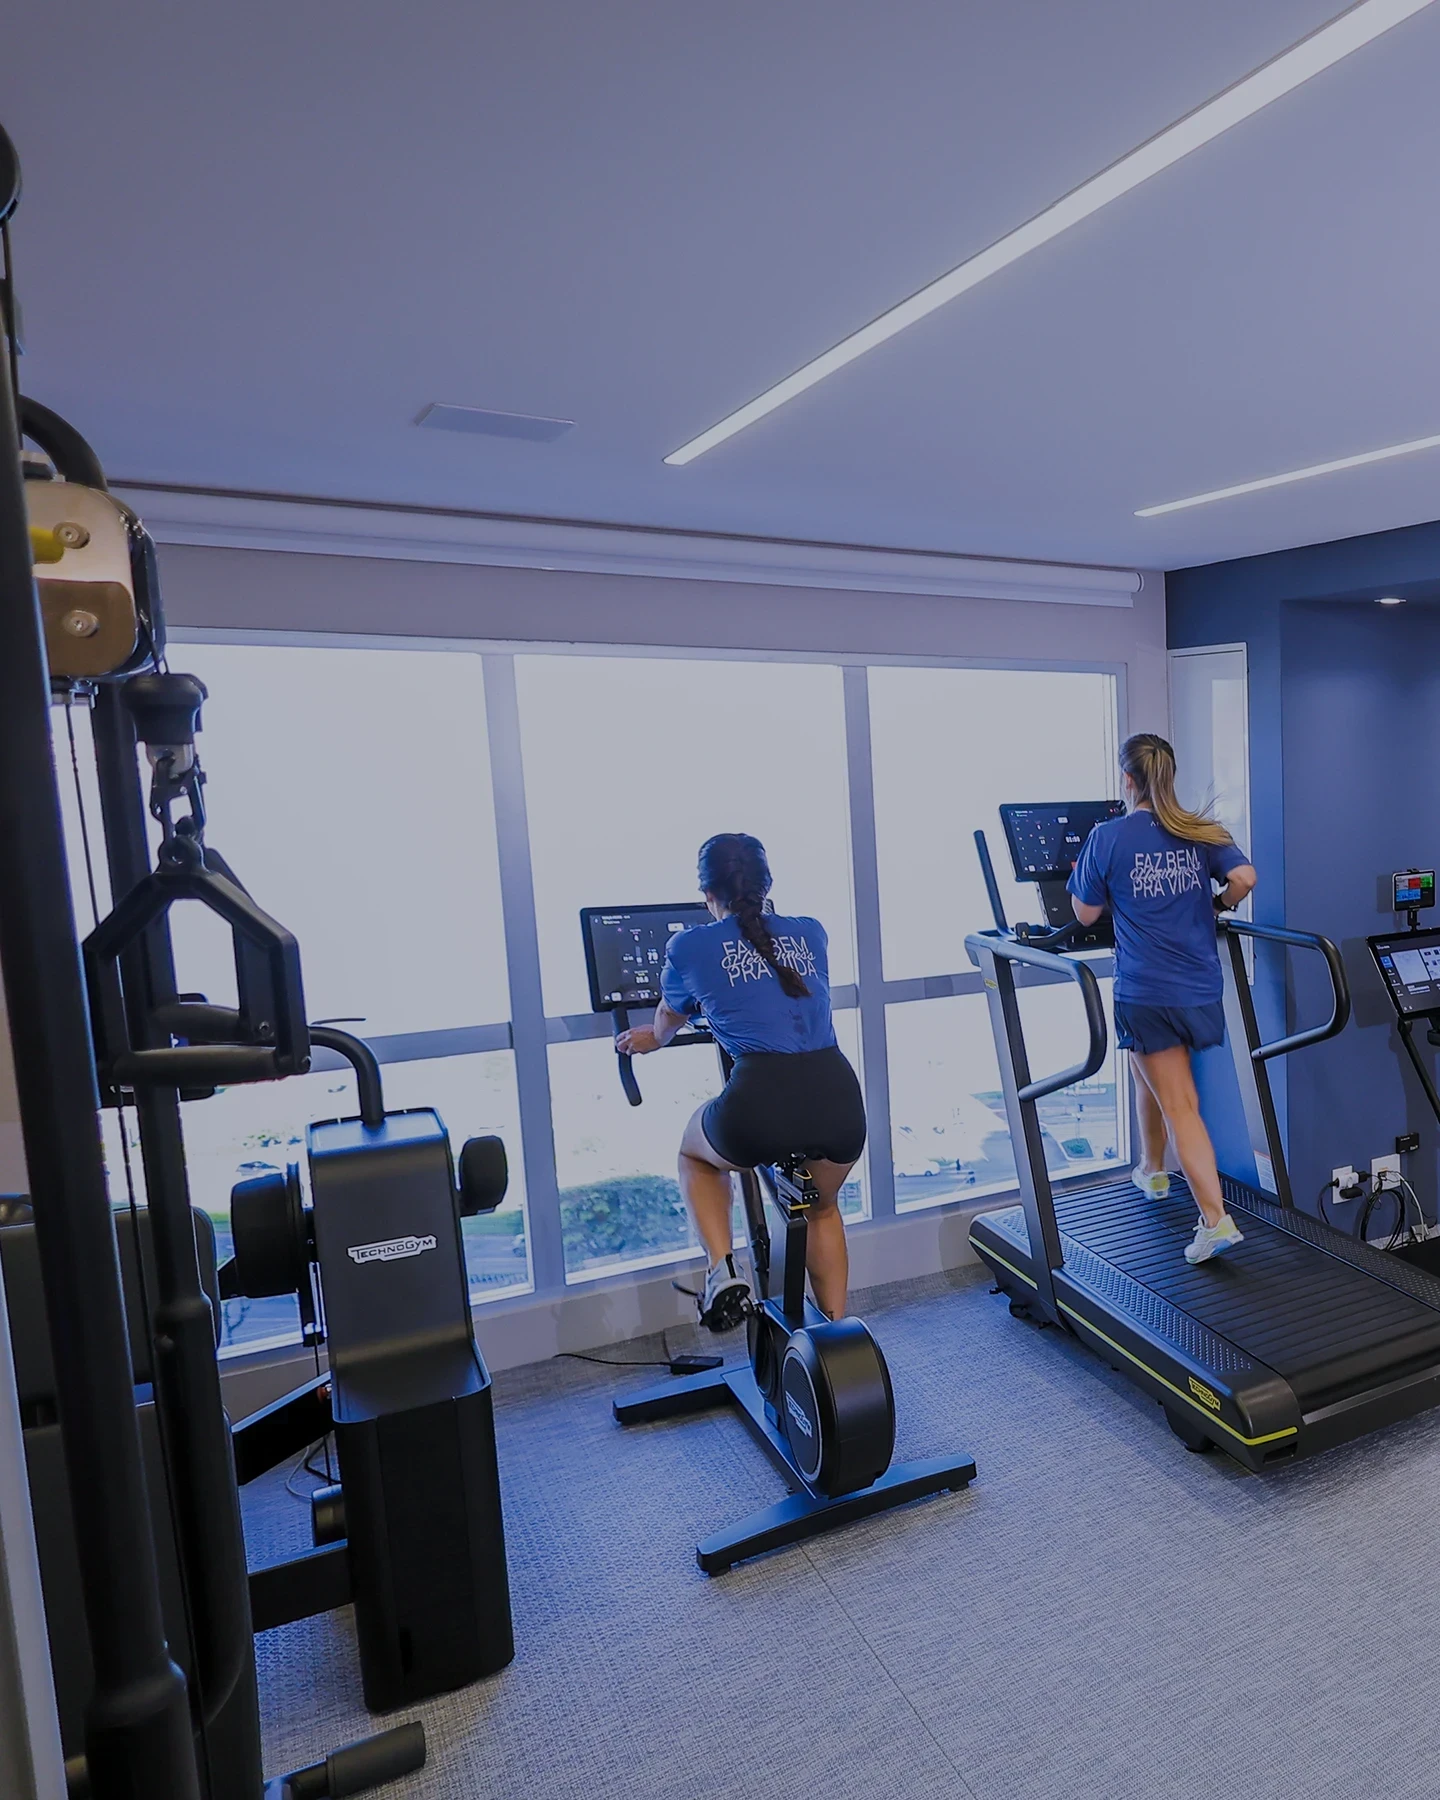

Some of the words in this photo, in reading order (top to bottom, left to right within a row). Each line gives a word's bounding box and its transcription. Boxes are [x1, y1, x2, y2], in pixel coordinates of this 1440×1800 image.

[1134, 852, 1162, 873] FAZ
[1166, 846, 1199, 870] BEM
[1132, 878, 1165, 898] PRA
[1166, 871, 1202, 895] VIDA
[727, 960, 773, 987] PRA
